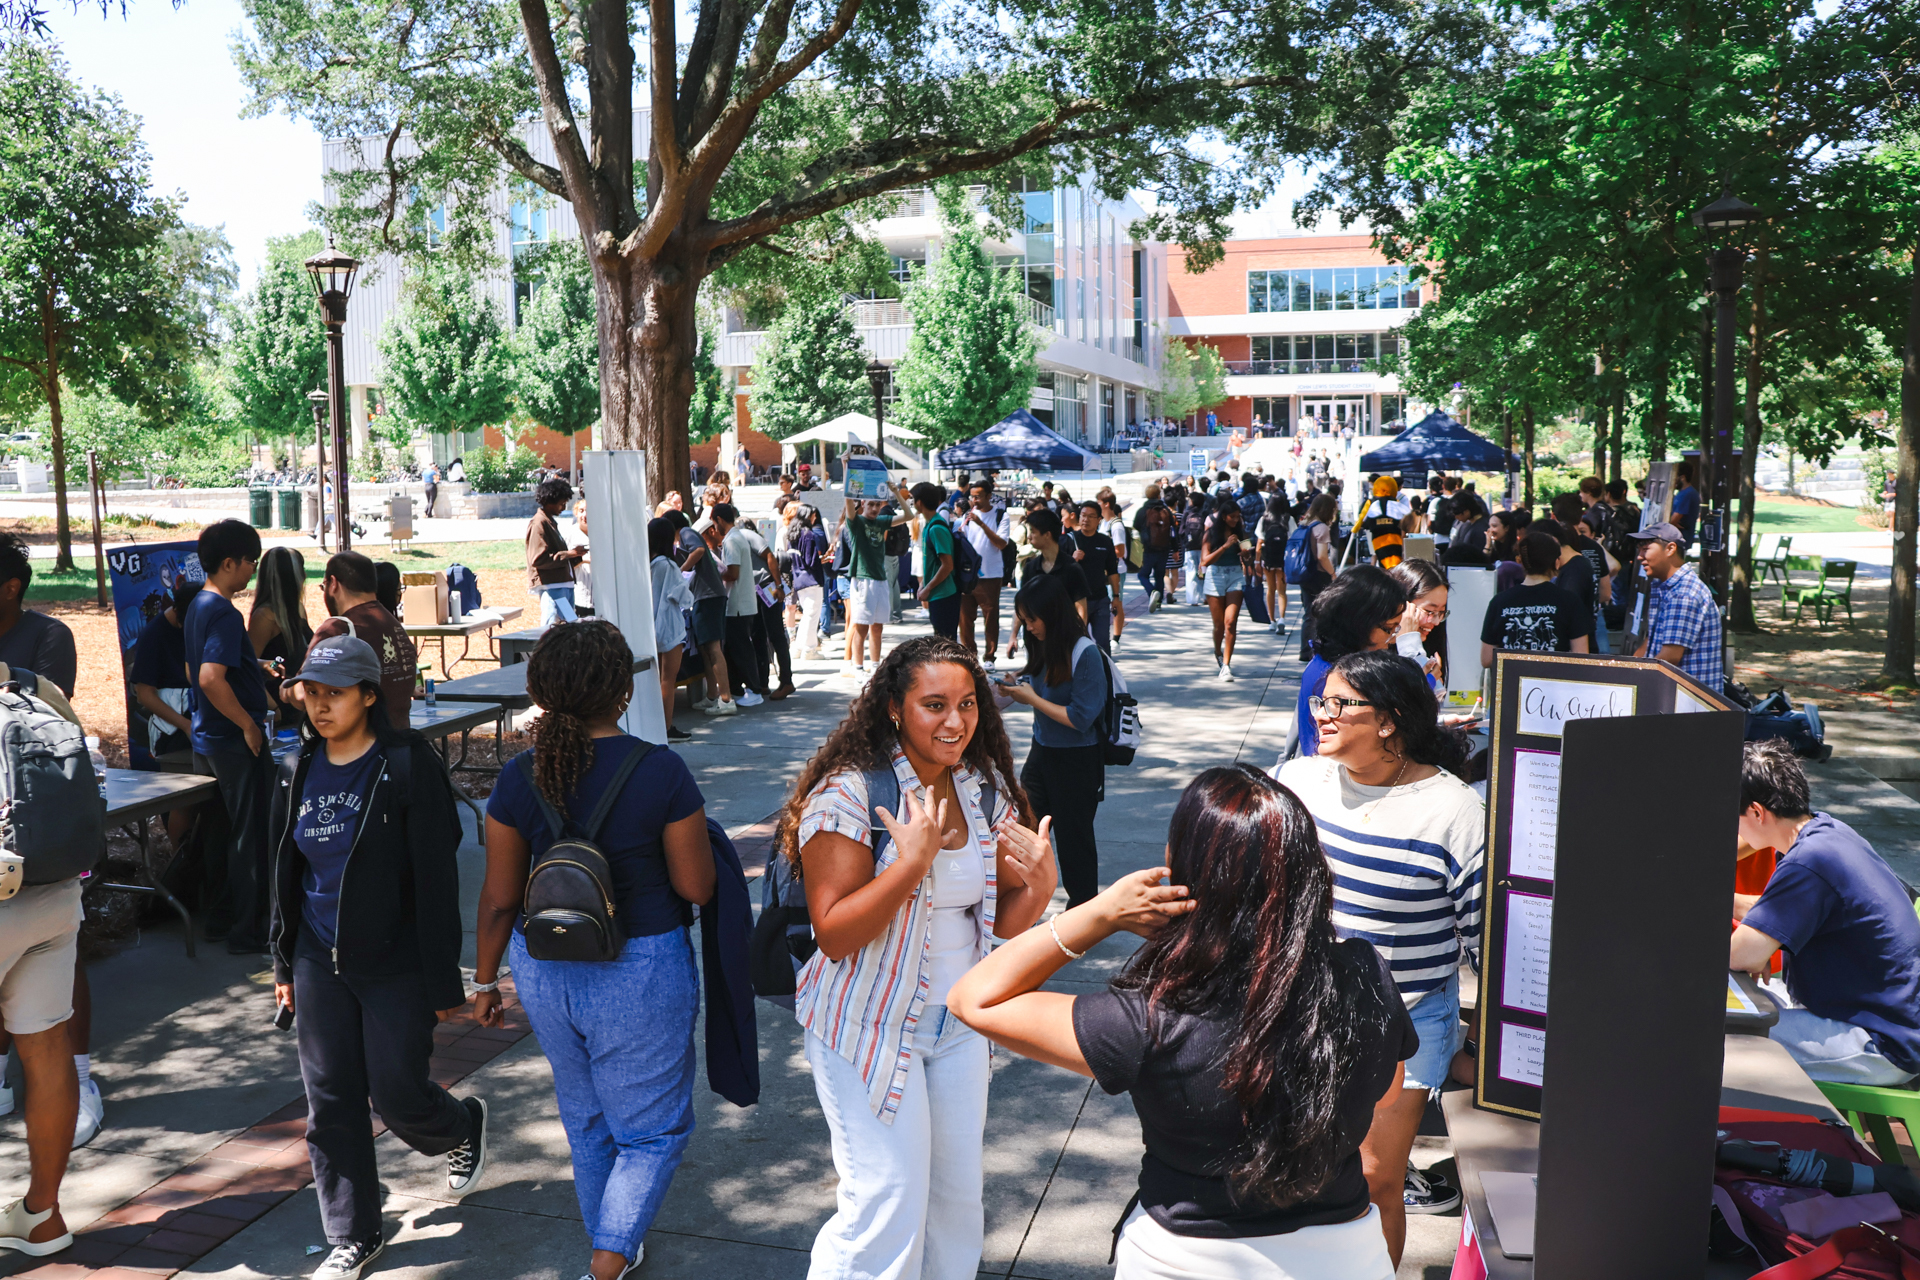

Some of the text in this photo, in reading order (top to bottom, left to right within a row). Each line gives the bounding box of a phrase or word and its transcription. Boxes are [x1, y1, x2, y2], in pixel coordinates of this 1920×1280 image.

[110, 552, 140, 574] VG
[1529, 771, 1559, 779] Championsh
[1523, 899, 1542, 907] SECOND
[1516, 1031, 1531, 1039] THIRD
